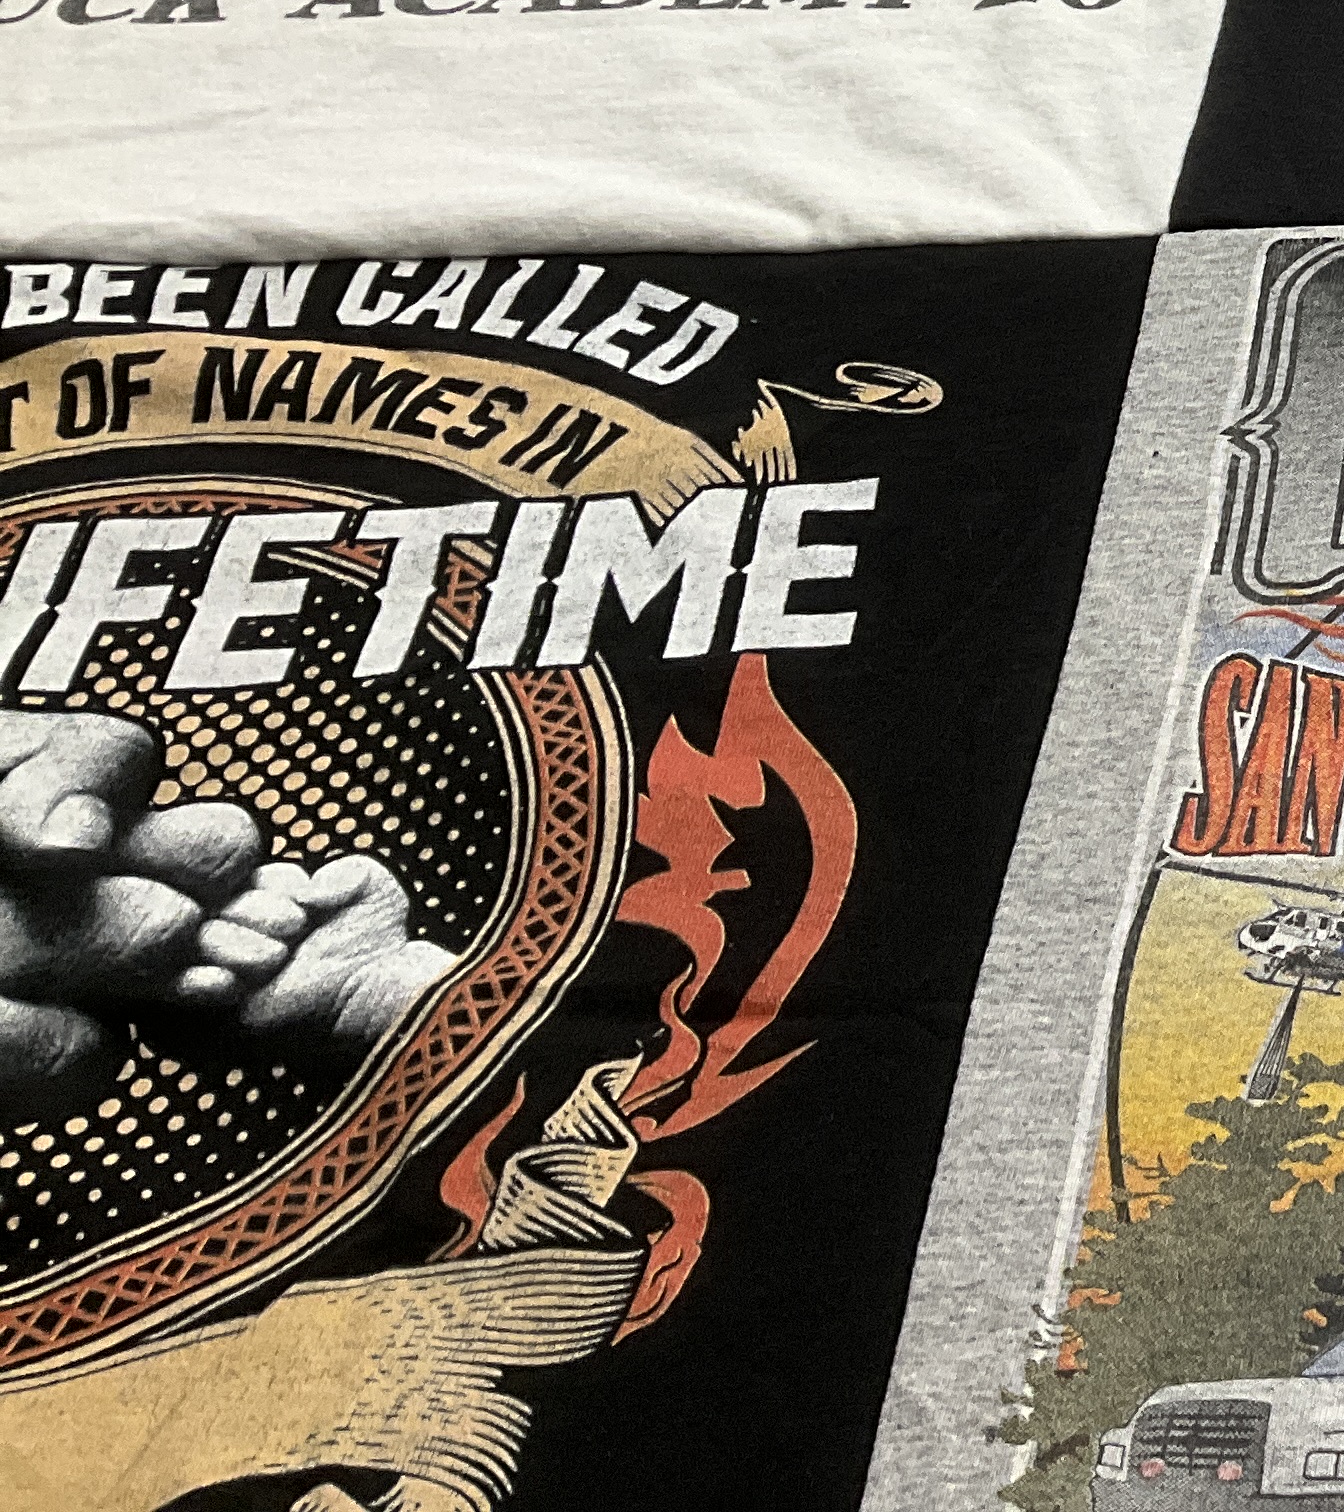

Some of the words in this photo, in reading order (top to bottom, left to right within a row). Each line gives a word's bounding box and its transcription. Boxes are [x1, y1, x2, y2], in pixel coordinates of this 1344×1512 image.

[3, 260, 328, 330] BEEN
[335, 258, 740, 388] CALLED
[55, 348, 166, 441] OF
[190, 346, 531, 452] NAMES
[498, 403, 631, 493] IN
